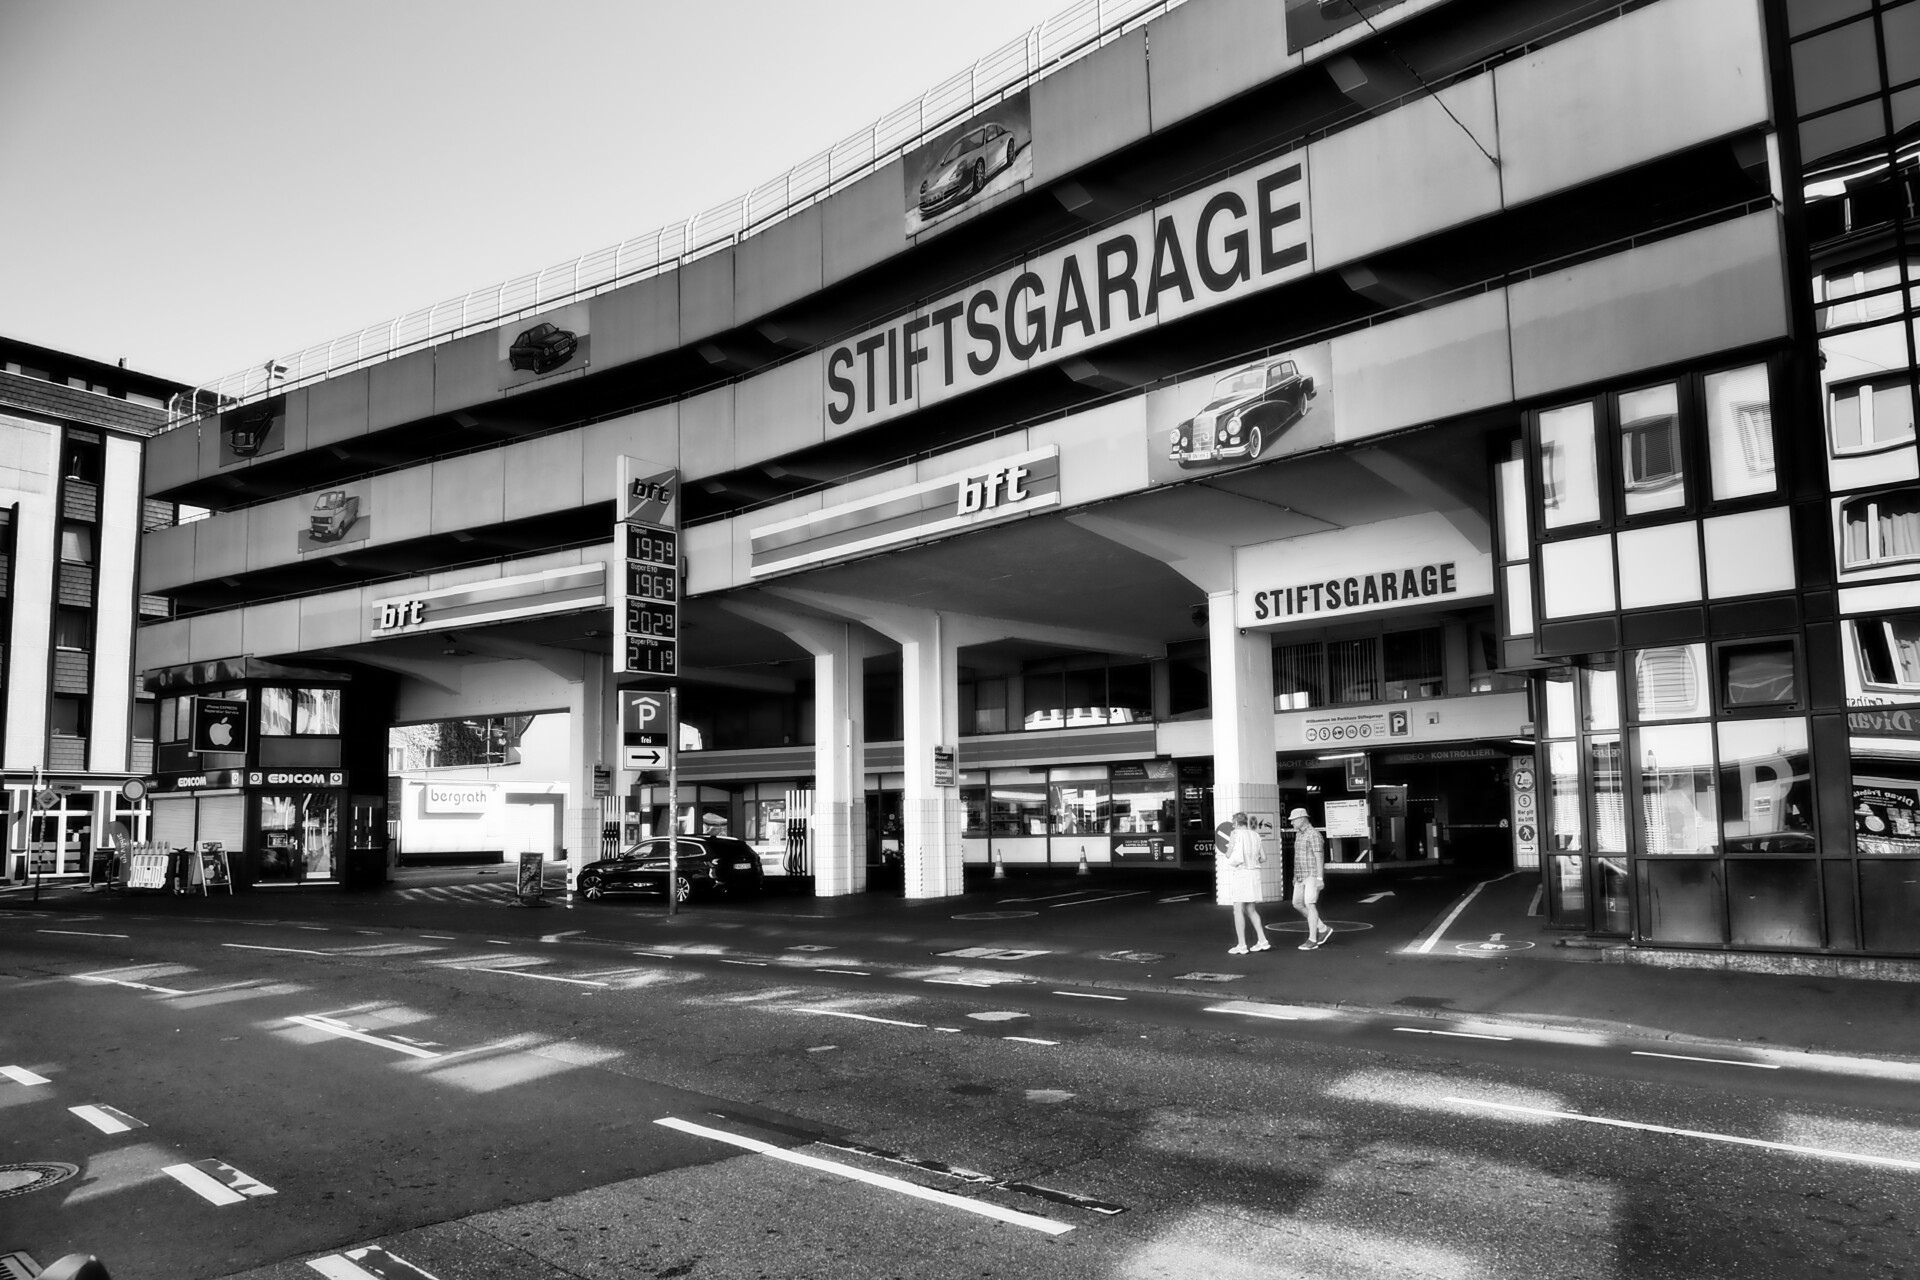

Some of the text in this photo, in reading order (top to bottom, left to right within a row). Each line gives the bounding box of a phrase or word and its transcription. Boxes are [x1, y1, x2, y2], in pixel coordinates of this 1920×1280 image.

[827, 163, 1308, 426] STIFTSGARAGE
[632, 478, 670, 505] bft
[957, 466, 1029, 516] bft
[630, 526, 647, 535] Diesel
[630, 562, 658, 573] Super E10
[1254, 562, 1457, 620] STIFTSGARAGE
[630, 600, 646, 608] Super
[380, 600, 423, 629] bft
[630, 637, 658, 646] Super Plus
[640, 736, 652, 744] frei
[1398, 753, 1425, 762] VIDEO
[178, 776, 206, 788] EDICOM
[267, 773, 325, 785] EDICOM
[430, 788, 487, 806] bergrath
